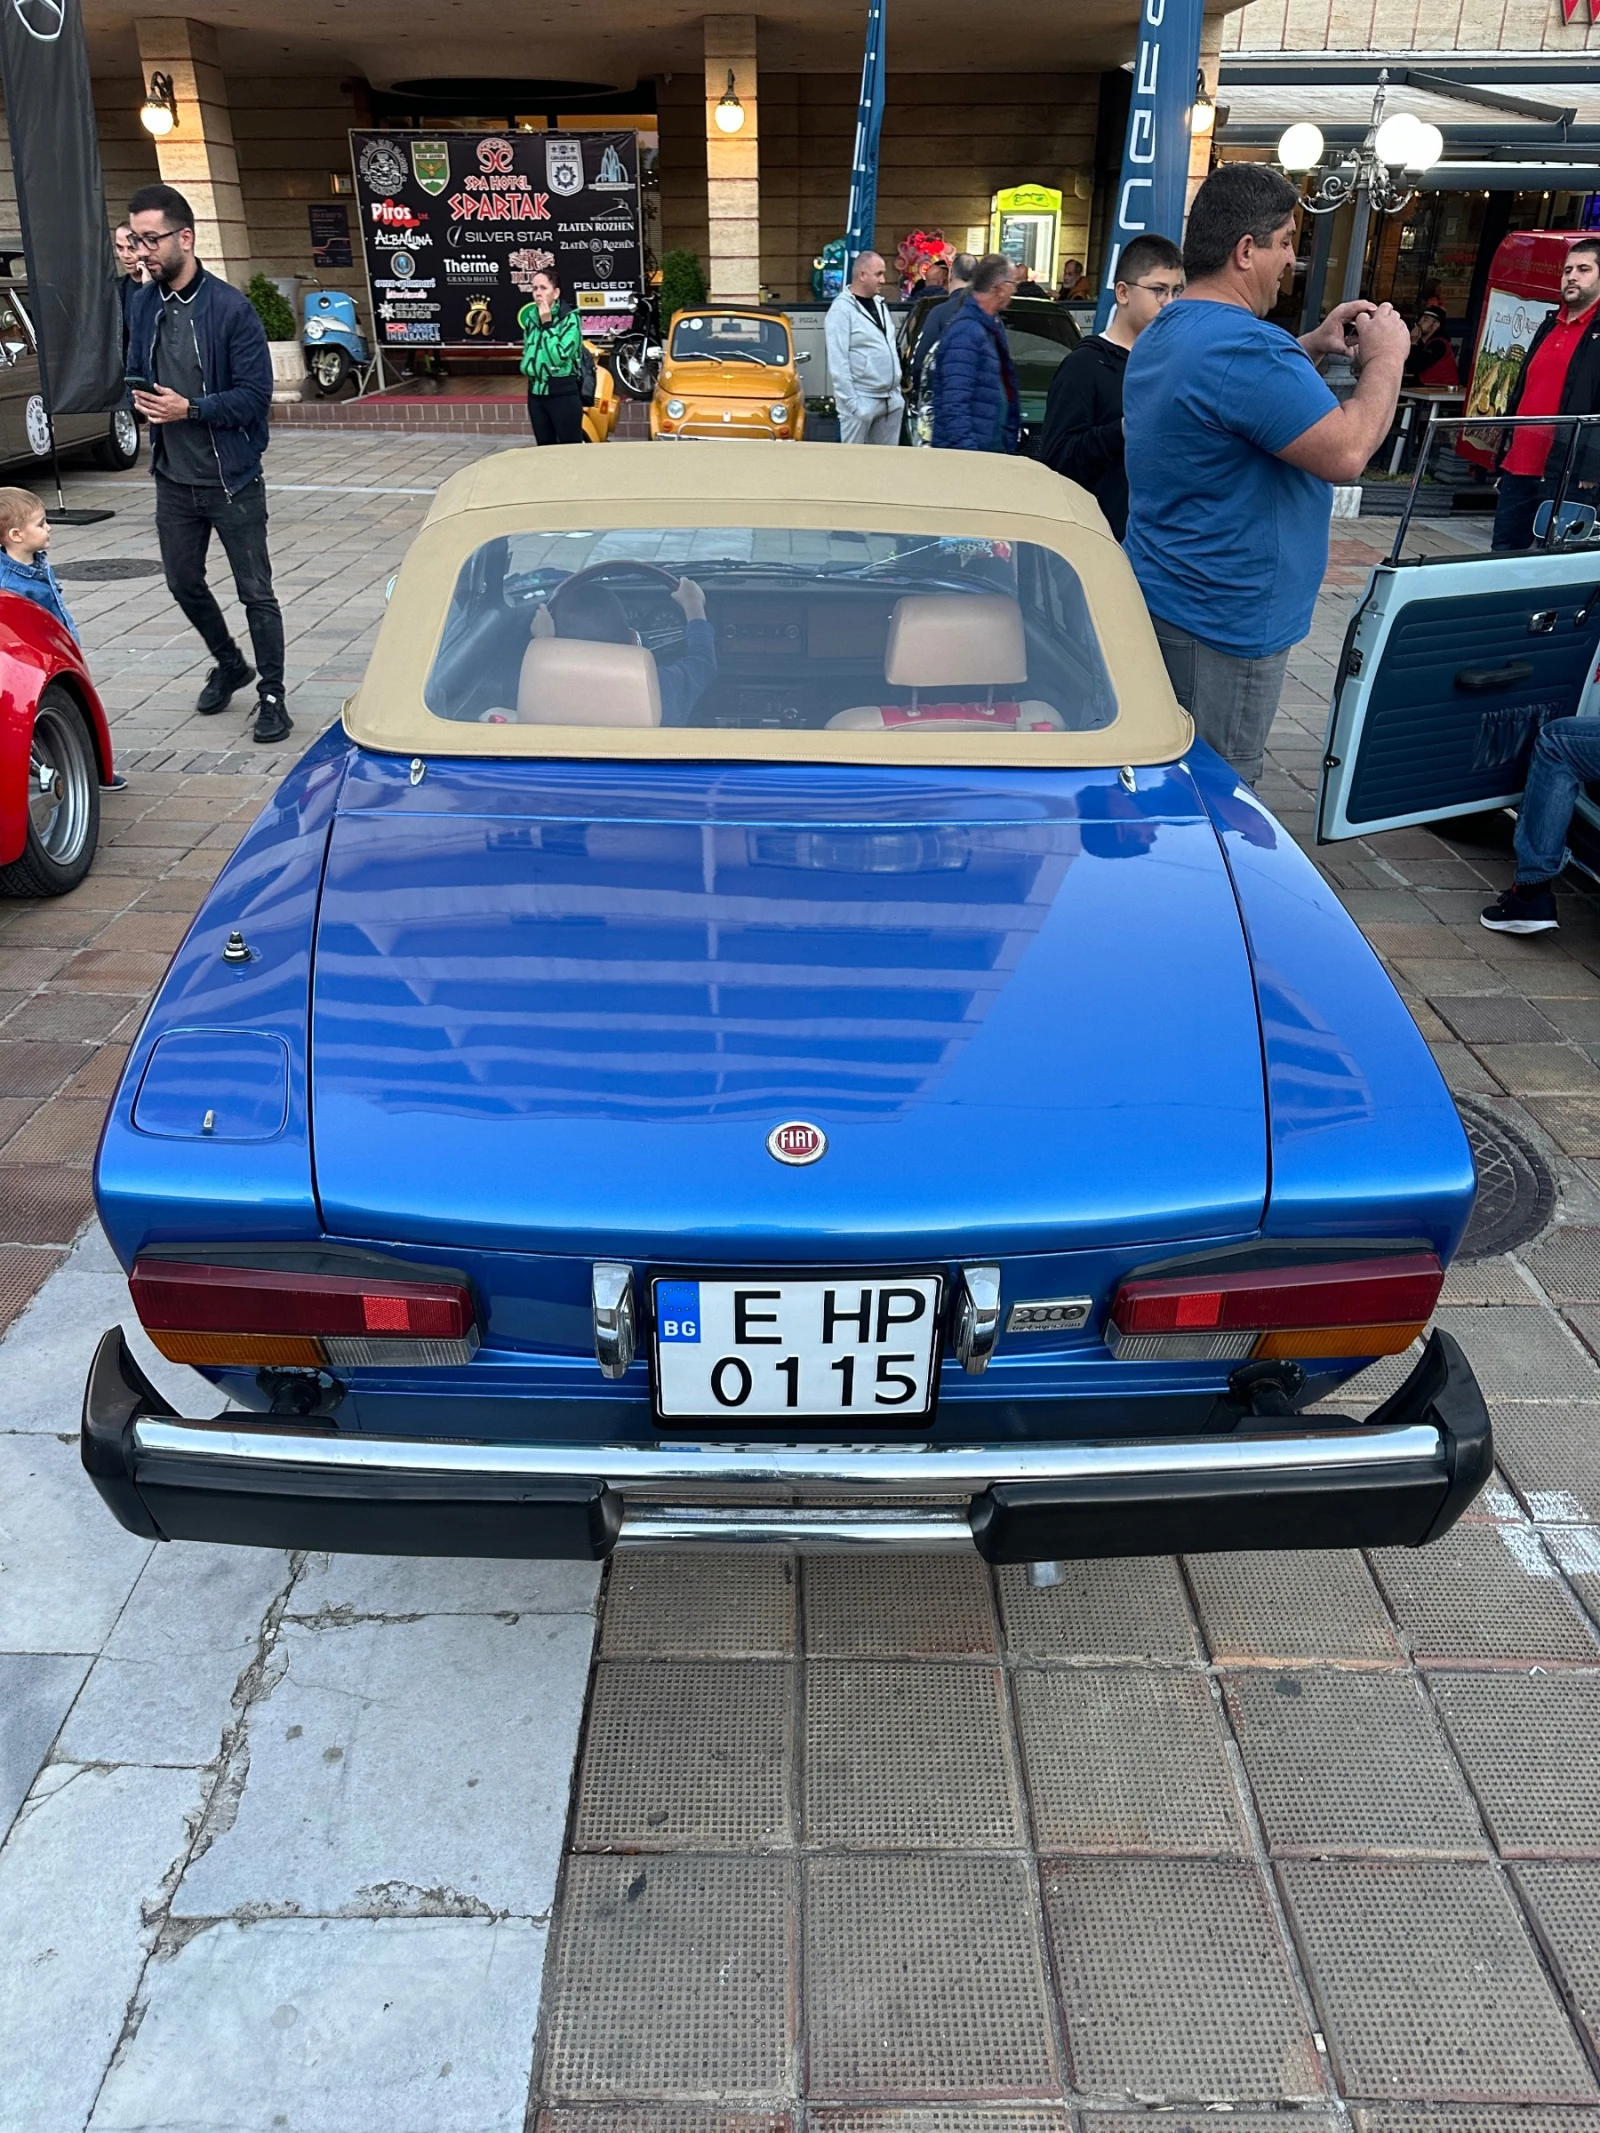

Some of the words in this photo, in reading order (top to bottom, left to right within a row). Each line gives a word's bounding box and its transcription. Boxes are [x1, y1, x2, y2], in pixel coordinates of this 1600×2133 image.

[464, 175, 489, 190] SPA
[489, 175, 532, 190] HOTEL
[371, 203, 412, 221] Piros
[447, 192, 552, 221] SPARTAK
[557, 222, 593, 232] ZLATEN
[594, 222, 635, 232] ROZHEN
[464, 231, 515, 243] SILVER
[516, 231, 554, 242] STAR
[443, 259, 500, 273] Therme
[573, 281, 635, 290] PEUGEOT
[406, 323, 441, 333] ASSET
[386, 332, 441, 341] INSURANCE
[779, 1130, 814, 1149] FIAT
[734, 1290, 783, 1345] E
[822, 1288, 926, 1345] HP
[664, 1321, 697, 1337] BG
[710, 1354, 917, 1408] 0115
